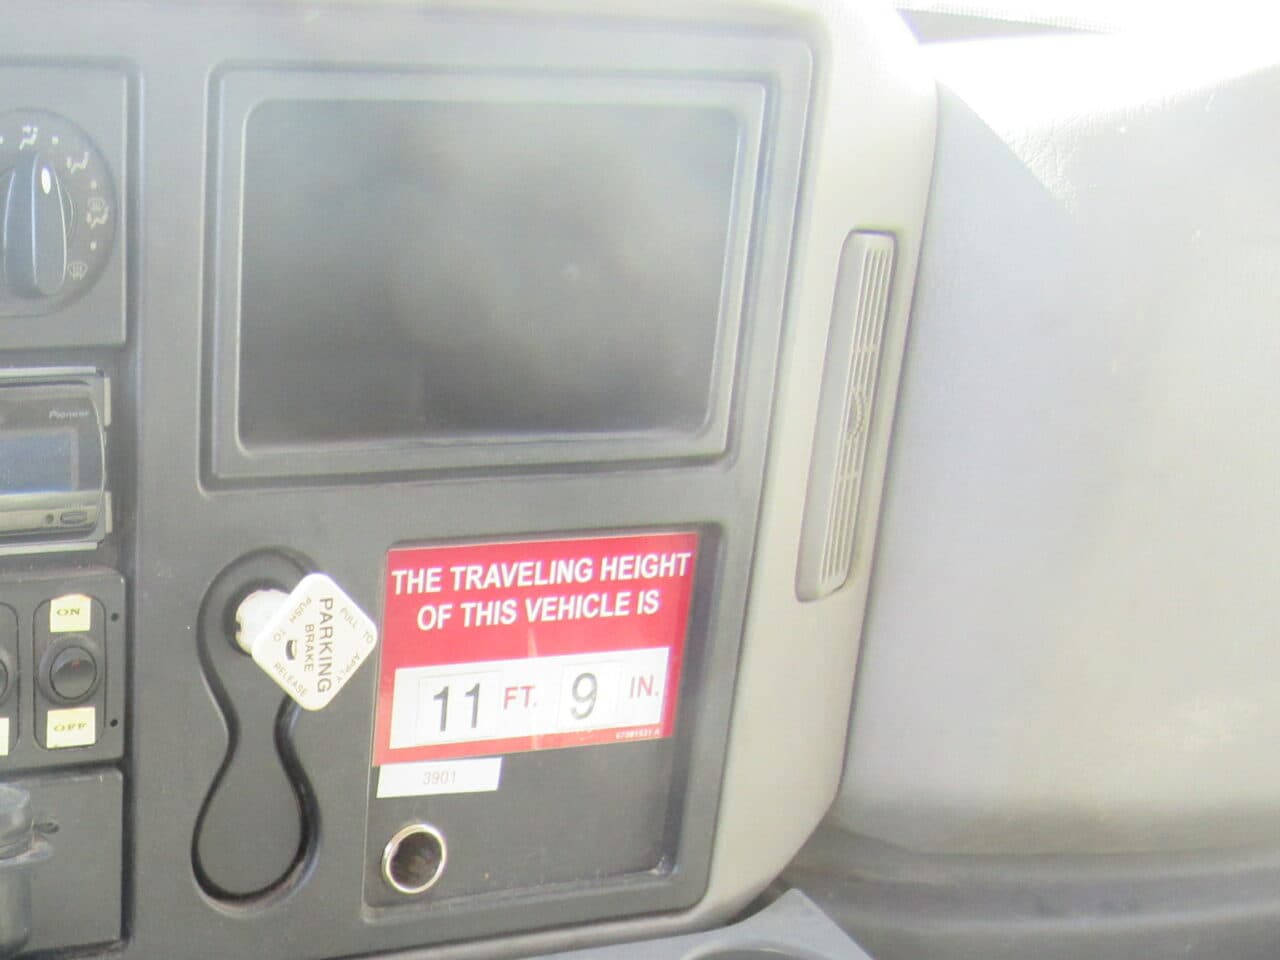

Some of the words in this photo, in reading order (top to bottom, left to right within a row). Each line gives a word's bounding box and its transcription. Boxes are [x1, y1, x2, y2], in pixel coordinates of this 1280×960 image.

[391, 567, 442, 595] THE
[449, 557, 595, 592] TRAVELING
[599, 552, 693, 582] HEIGHT
[56, 606, 82, 619] ON
[416, 604, 454, 631] OF
[460, 599, 518, 627] THIS
[523, 593, 632, 623] VEHICLE
[636, 589, 660, 616] IS
[304, 623, 316, 673] BRAKE
[316, 597, 335, 694] PARKING
[273, 661, 310, 699] RELEASE
[432, 680, 481, 733] 11
[502, 684, 538, 711] FT.
[570, 671, 599, 721] 9
[628, 675, 660, 700] IN.
[52, 721, 89, 734] OFF
[422, 770, 457, 787] 3901
